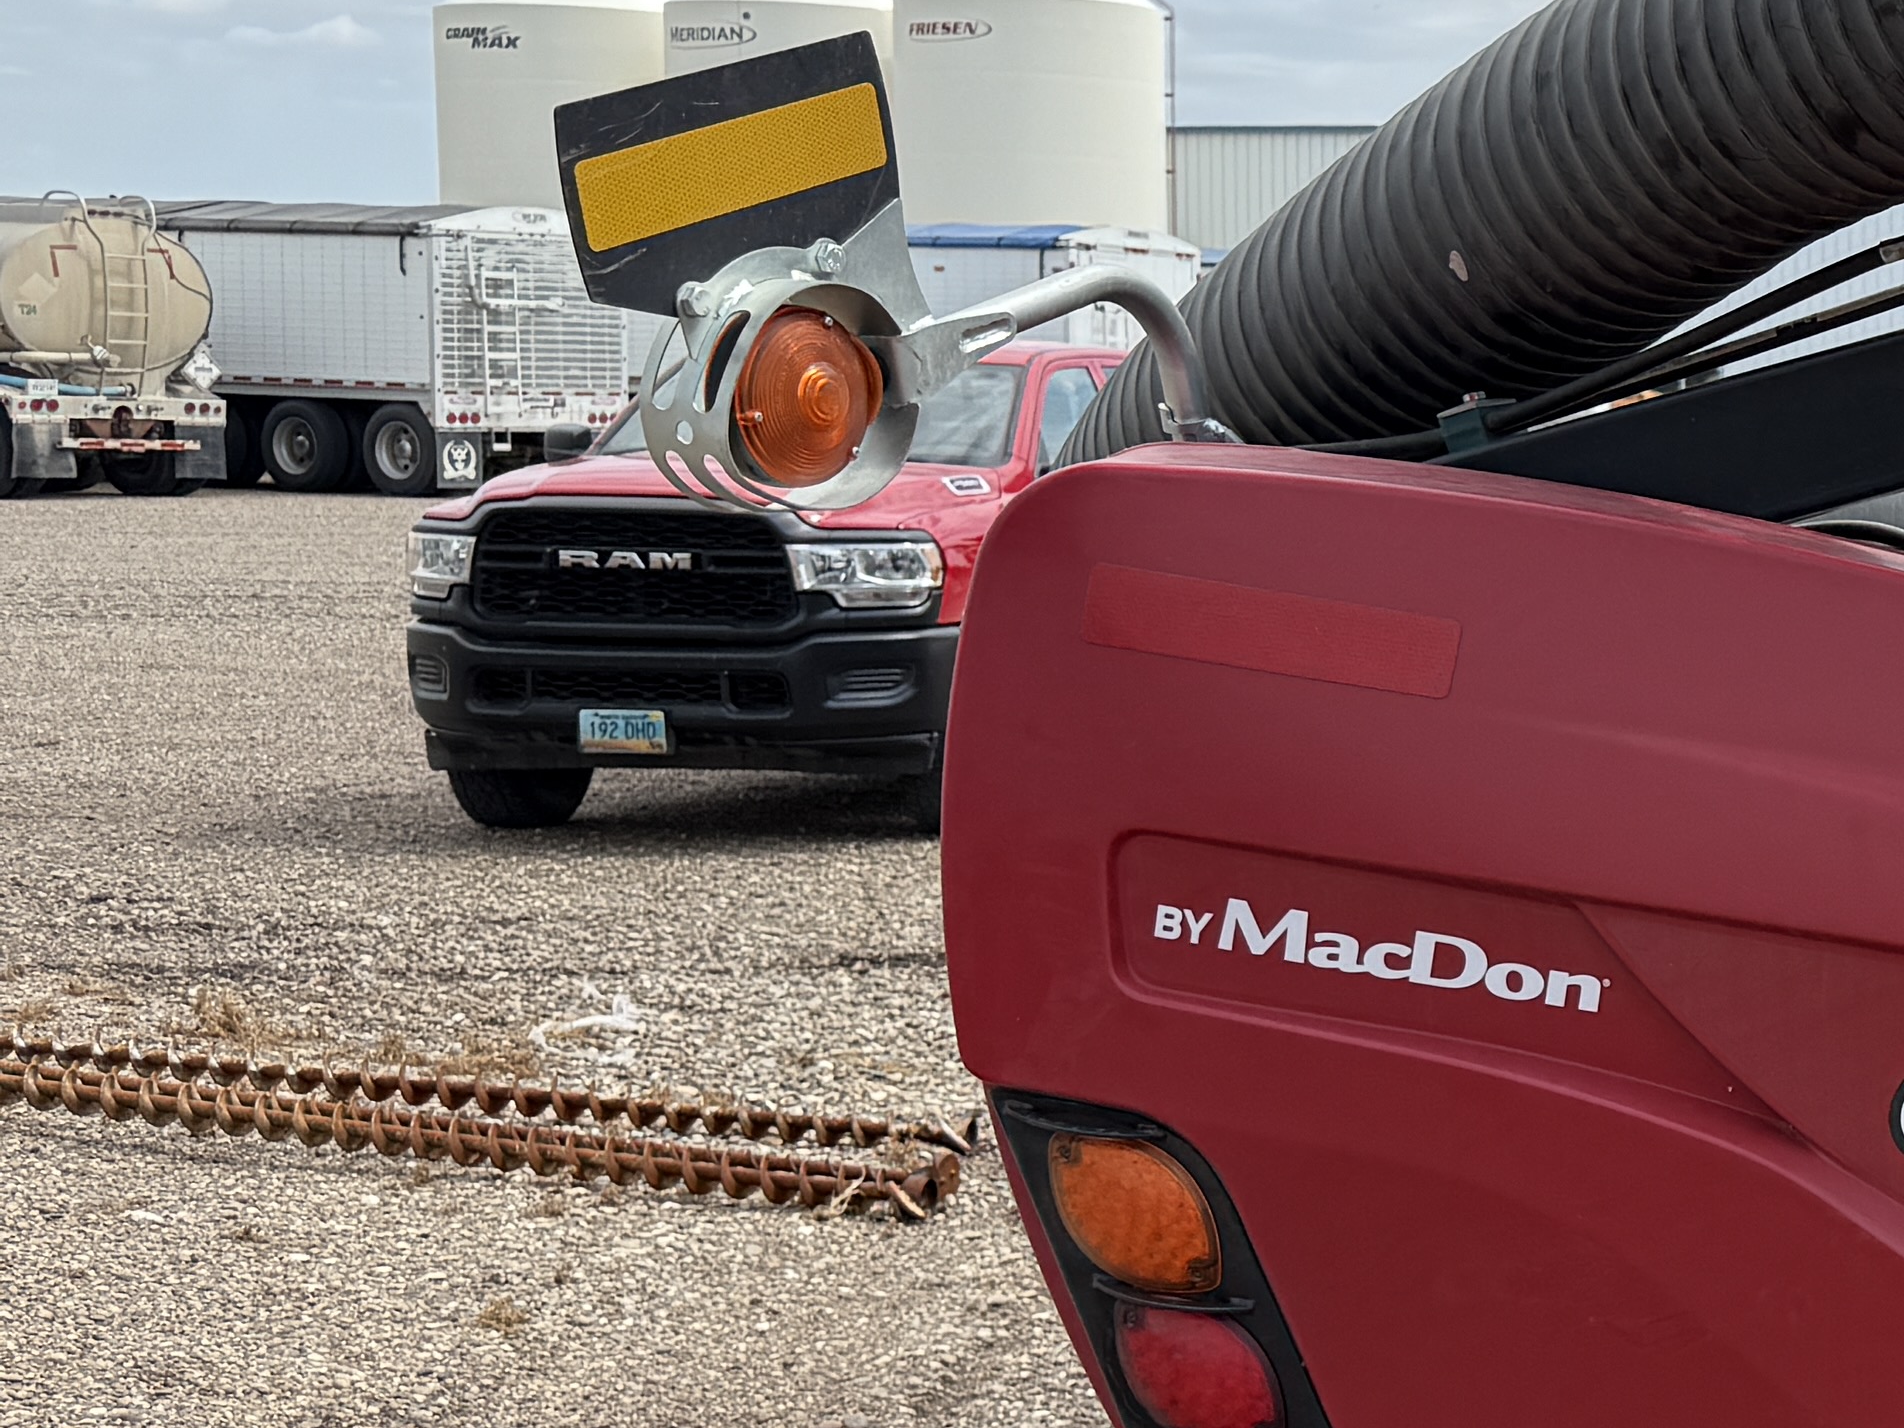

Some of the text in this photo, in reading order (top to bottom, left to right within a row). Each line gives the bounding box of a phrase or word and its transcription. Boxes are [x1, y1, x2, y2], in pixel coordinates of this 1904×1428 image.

[669, 25, 744, 43] MERIDIAN
[908, 19, 979, 37] FRIESEN
[471, 34, 521, 50] MAX
[558, 549, 693, 570] RAM
[590, 720, 619, 740] 192
[1153, 903, 1215, 945] BY
